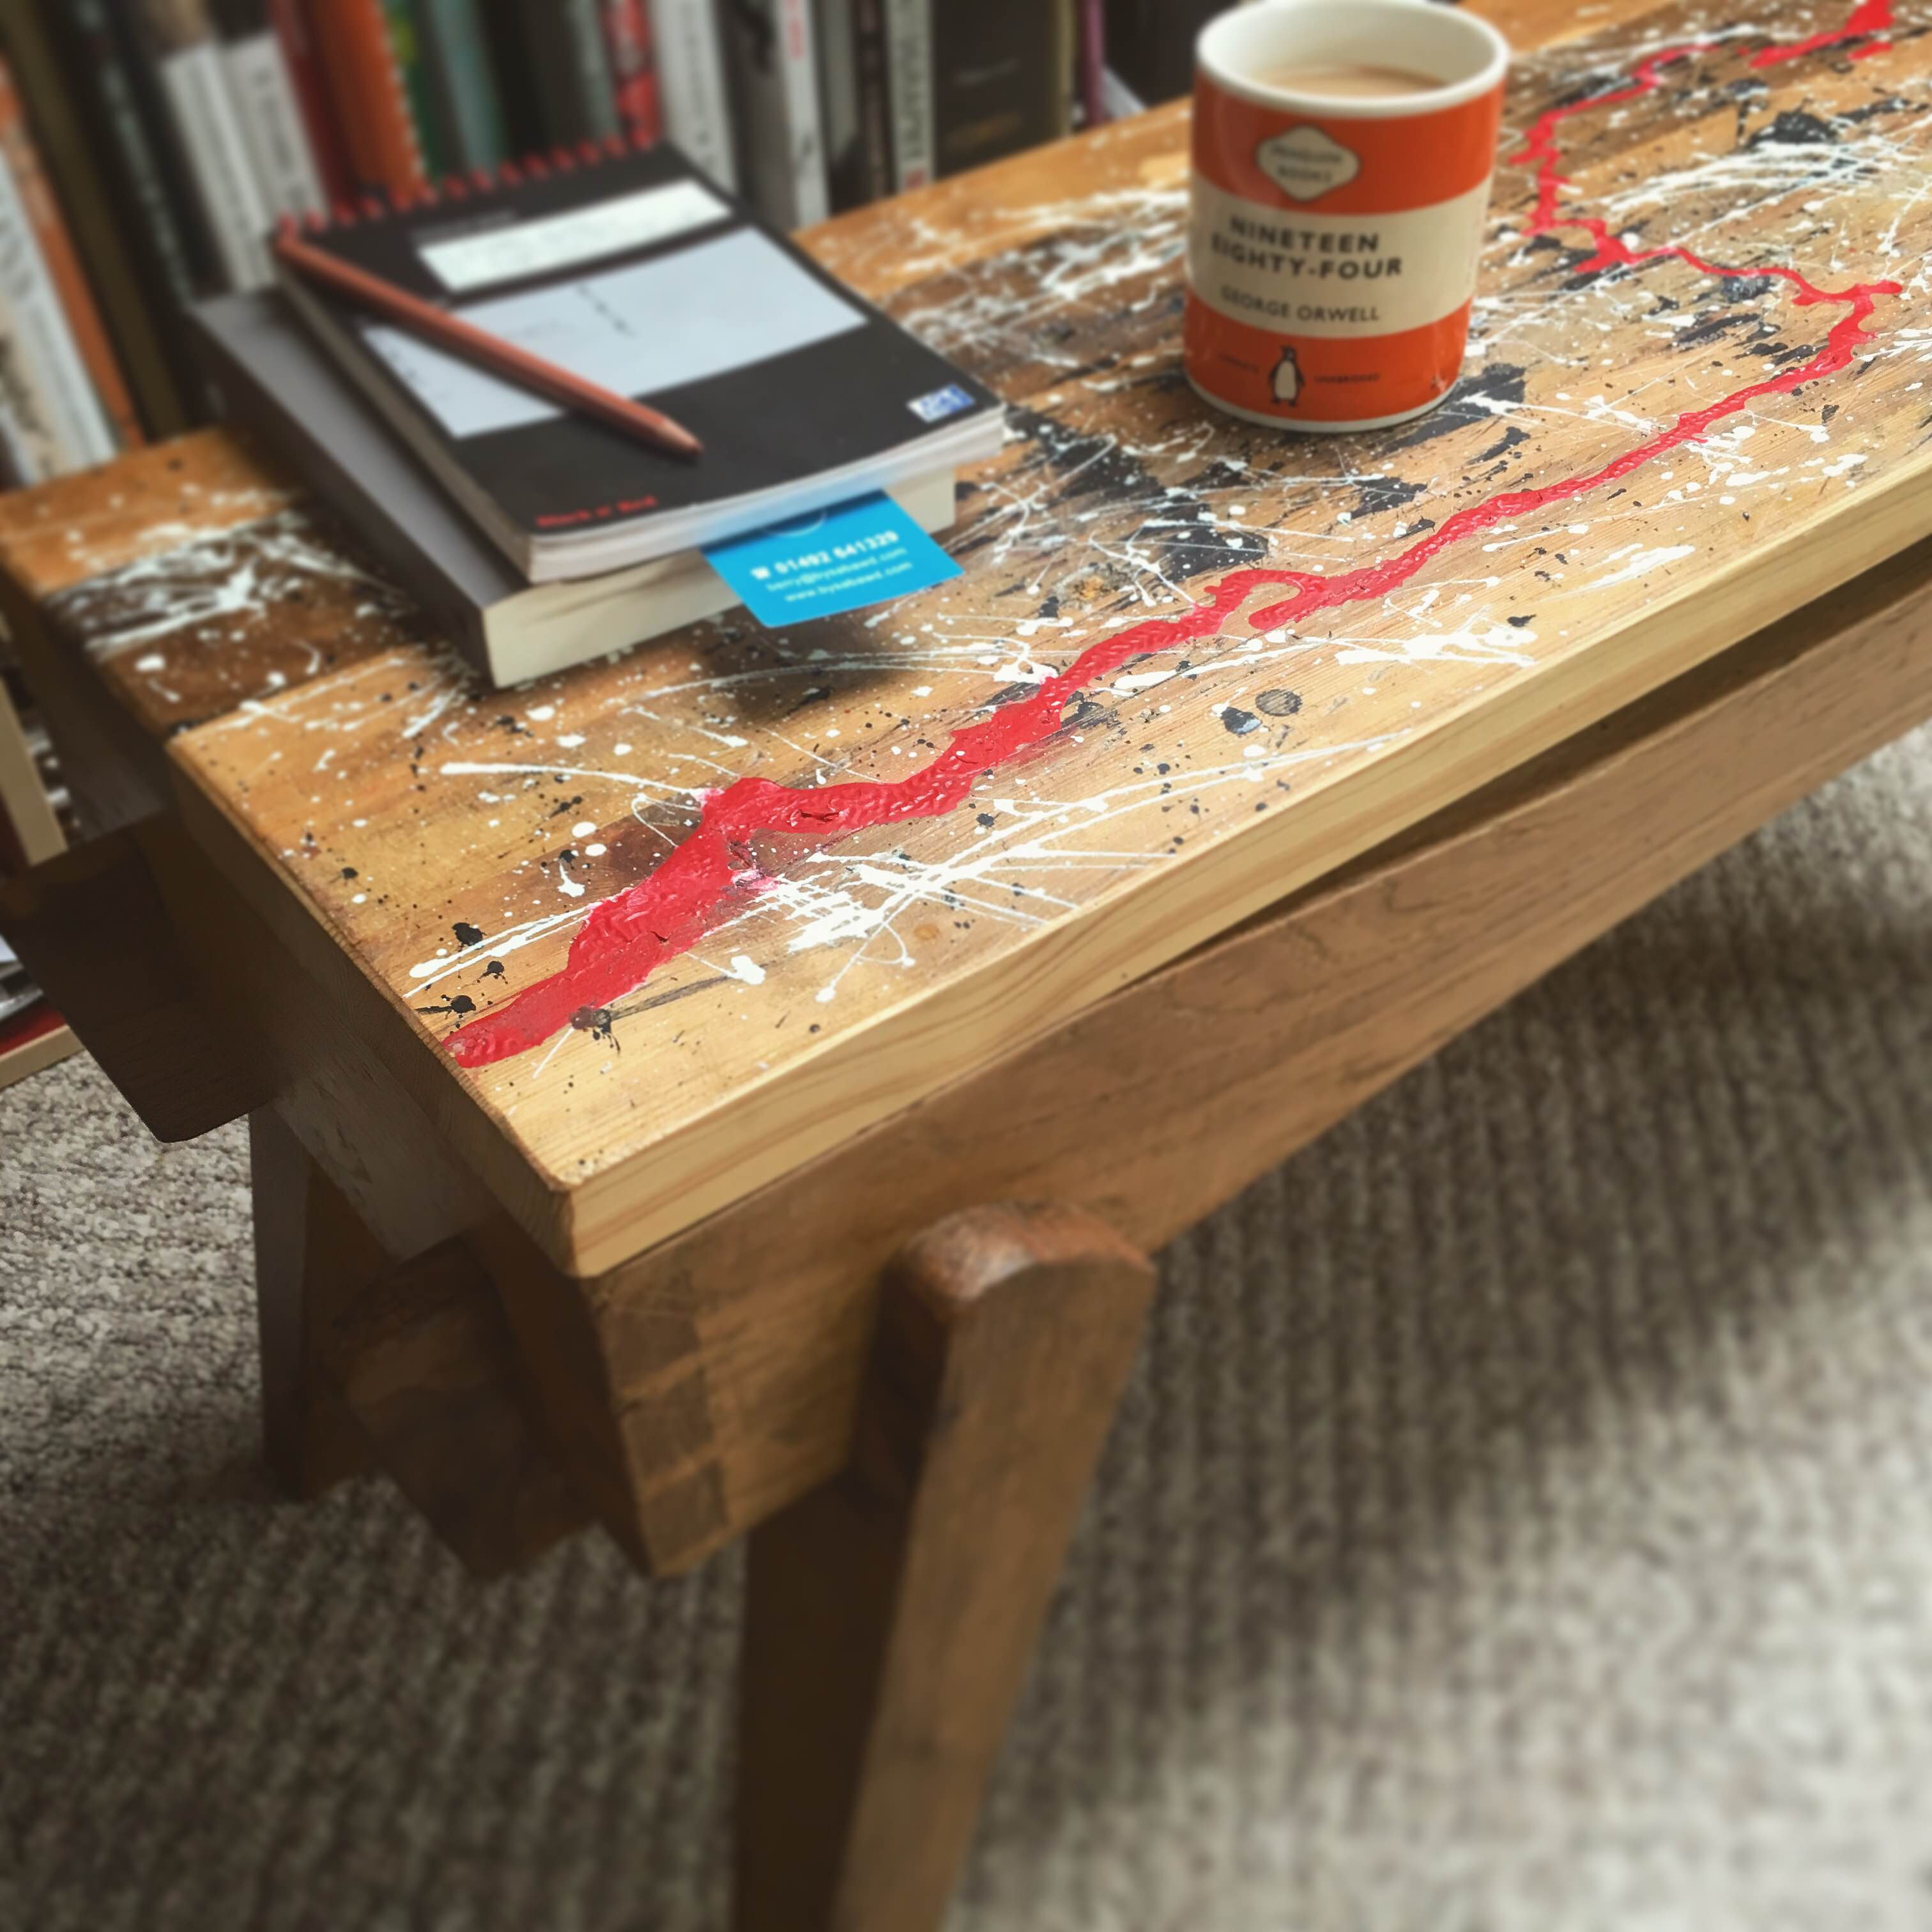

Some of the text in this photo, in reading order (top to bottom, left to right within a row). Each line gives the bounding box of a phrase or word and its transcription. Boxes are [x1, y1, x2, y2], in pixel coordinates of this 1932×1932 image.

[1230, 216, 1379, 254] NINETEEN
[1212, 232, 1403, 280] EIGHTY-FOUR
[1221, 285, 1380, 322] GEORGE ORWELL
